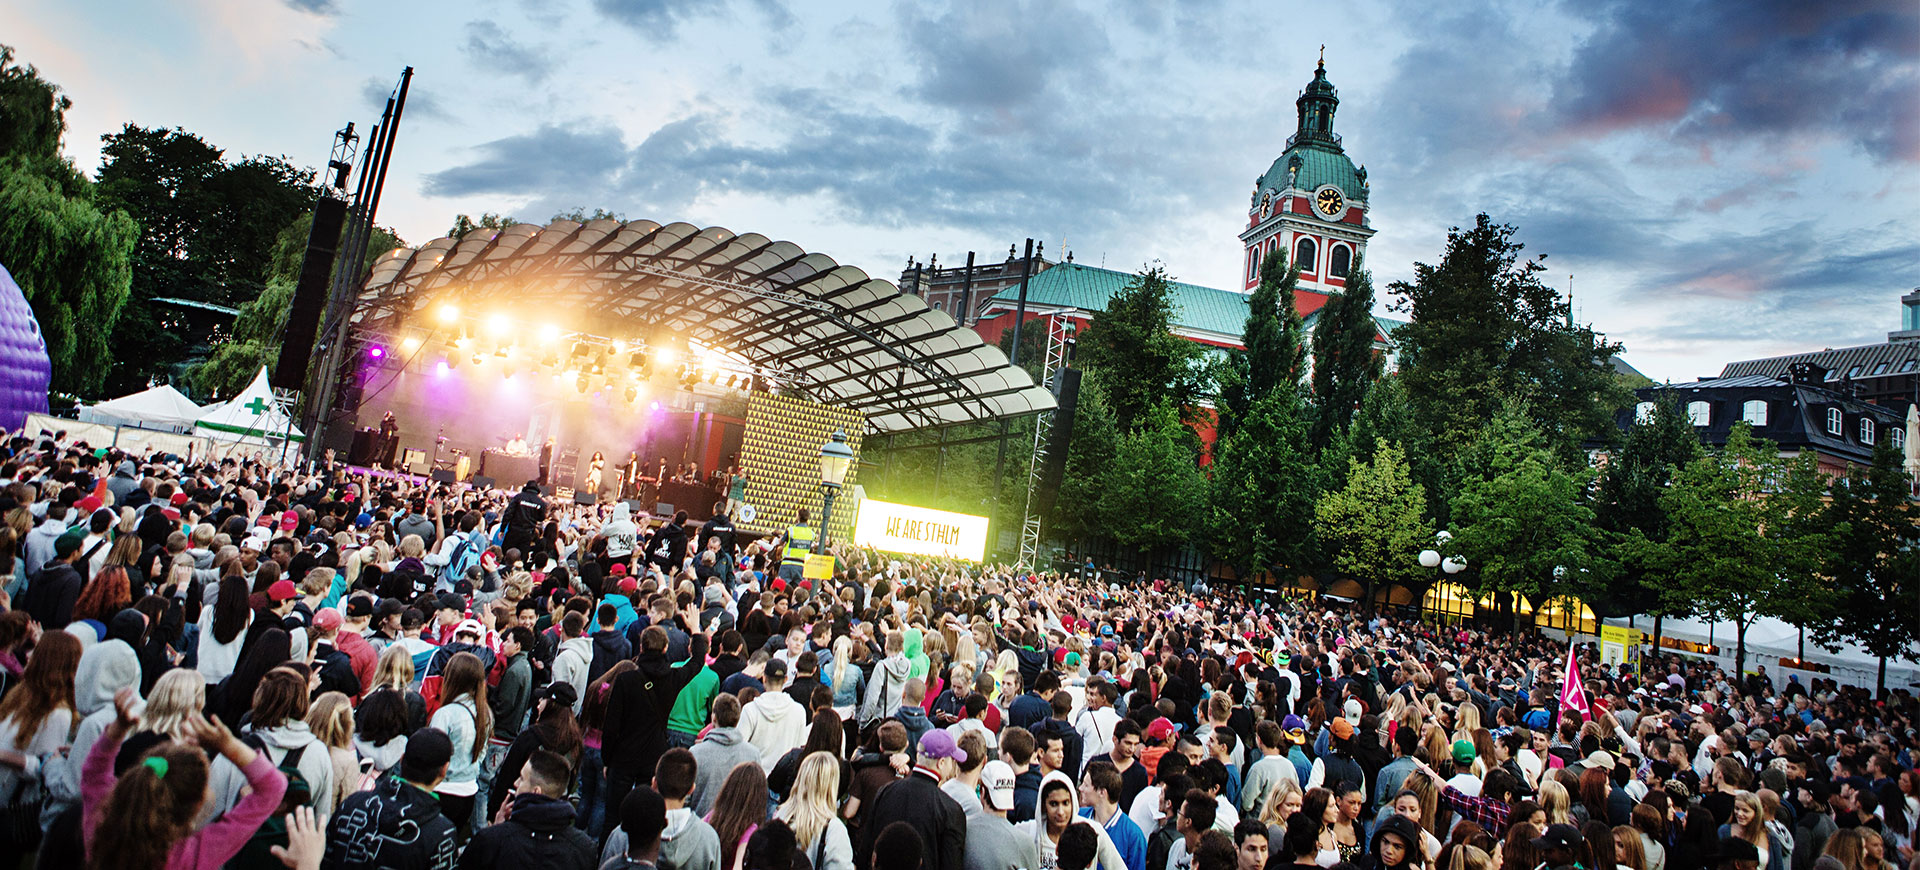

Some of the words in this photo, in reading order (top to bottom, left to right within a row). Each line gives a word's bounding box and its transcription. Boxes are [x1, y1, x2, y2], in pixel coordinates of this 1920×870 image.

[886, 516, 901, 537] WE
[902, 519, 923, 541] ARE
[925, 521, 960, 546] STHLM
